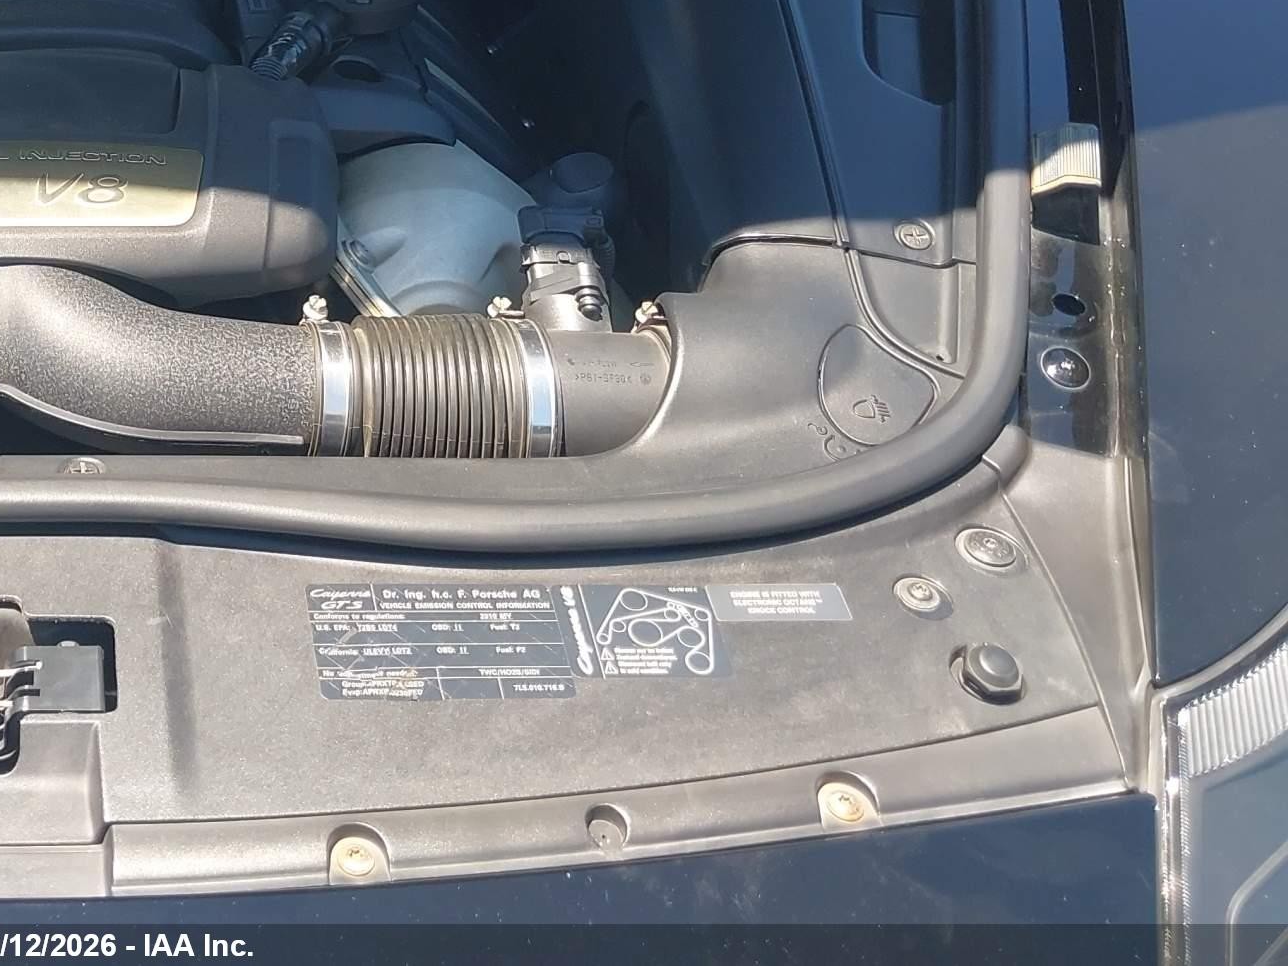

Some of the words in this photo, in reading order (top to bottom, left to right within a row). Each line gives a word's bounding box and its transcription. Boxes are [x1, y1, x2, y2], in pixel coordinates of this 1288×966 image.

[19, 150, 168, 165] INJECTION
[36, 172, 129, 205] V8
[310, 588, 371, 600] Cayenne
[382, 589, 399, 599] Dr.
[405, 589, 426, 600] Ing.
[431, 589, 452, 599] h.c.
[457, 589, 467, 599] F.
[471, 589, 518, 599] Porsche
[523, 589, 541, 599] AG
[762, 590, 770, 599] IS
[771, 590, 798, 599] FITTED
[799, 590, 820, 599] WITH
[320, 600, 363, 610] GTS
[380, 602, 412, 610] VEHICLE
[414, 602, 454, 610] EMISSION
[456, 602, 494, 610] CONTROL
[496, 602, 551, 610] INFORMATION
[436, 646, 456, 654] OBD:
